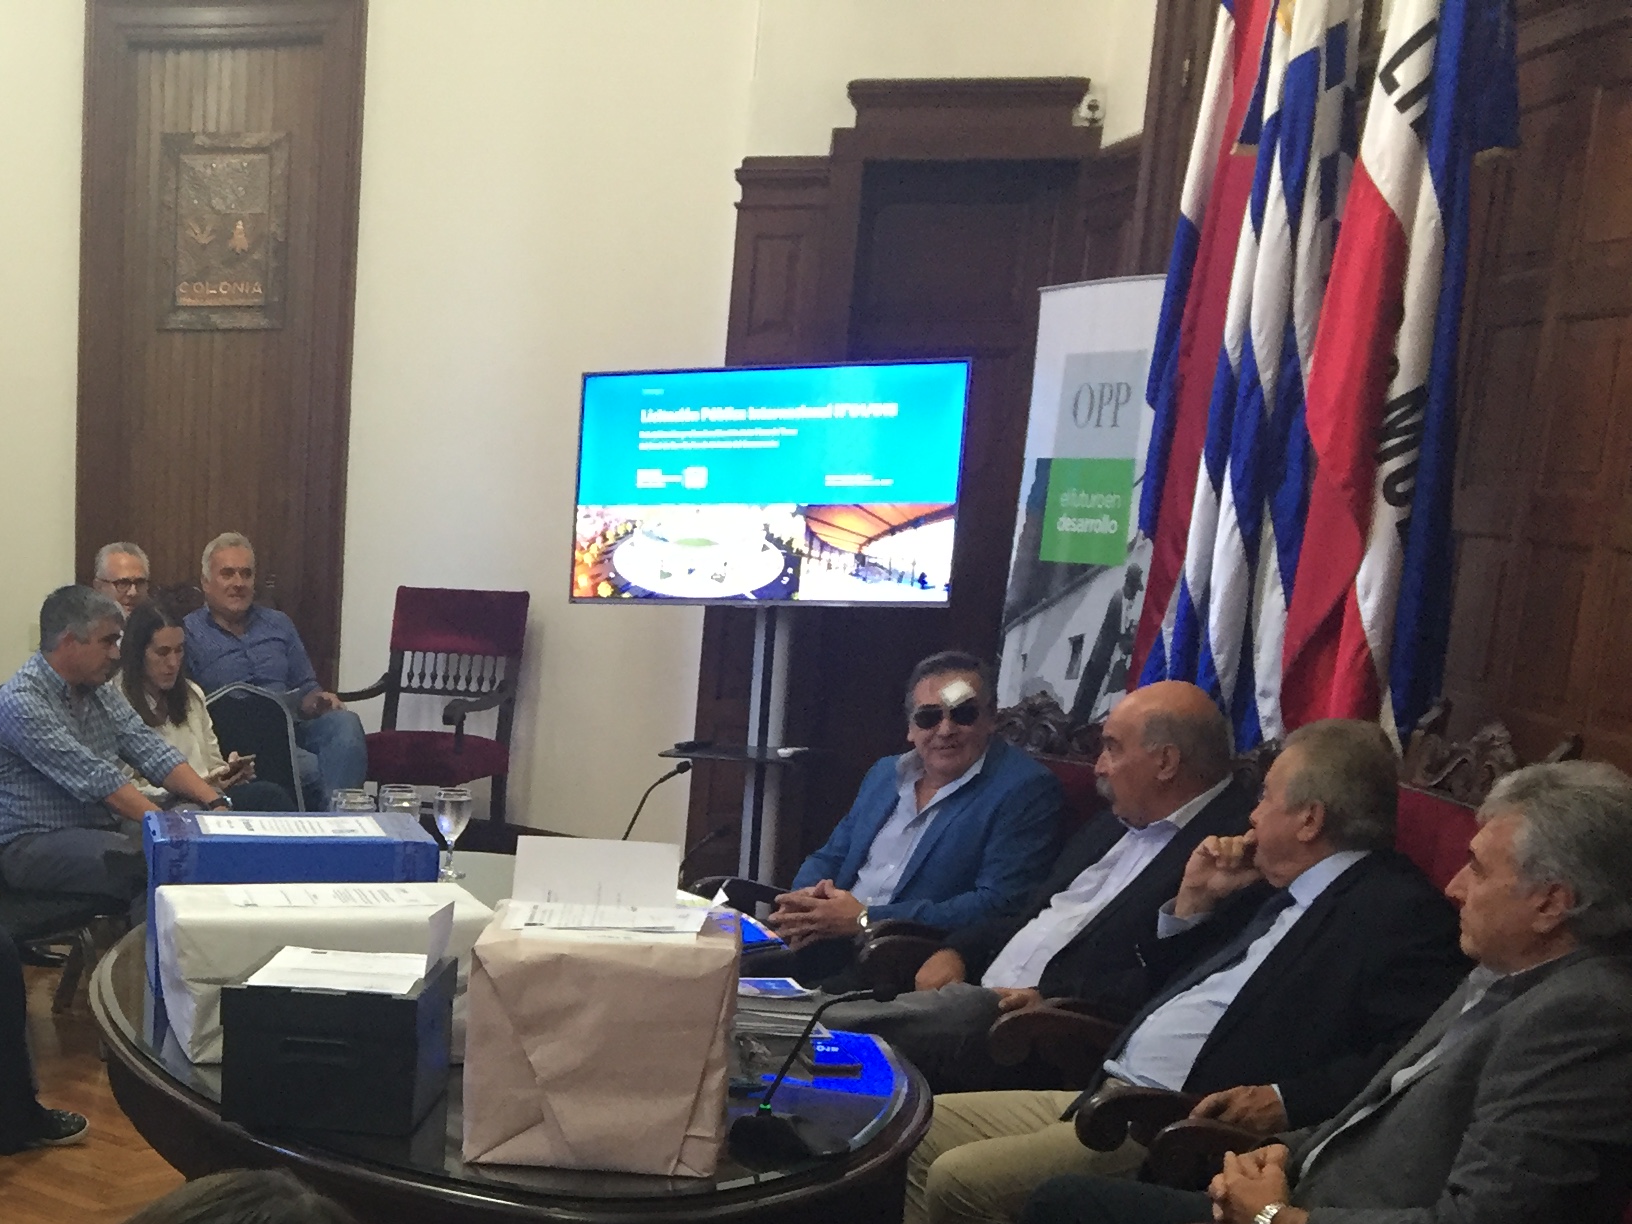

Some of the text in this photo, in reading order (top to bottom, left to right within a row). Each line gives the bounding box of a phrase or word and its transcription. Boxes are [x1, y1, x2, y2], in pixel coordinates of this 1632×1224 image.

[179, 281, 262, 295] COLONIA
[1072, 382, 1132, 428] OPP
[1056, 513, 1118, 534] desarrollo
